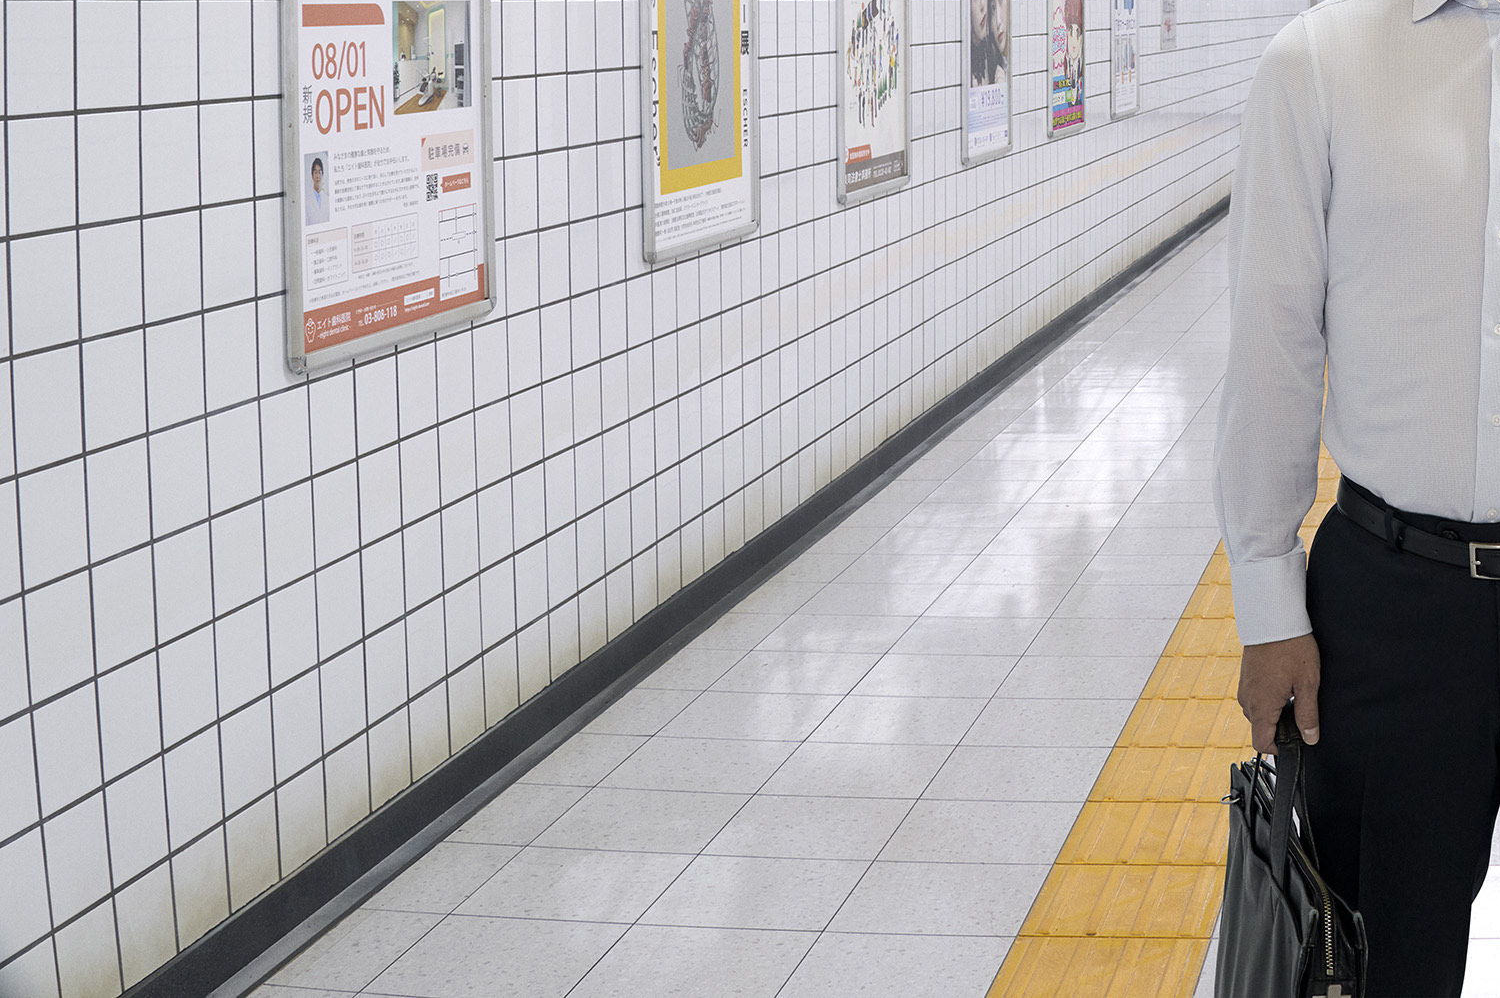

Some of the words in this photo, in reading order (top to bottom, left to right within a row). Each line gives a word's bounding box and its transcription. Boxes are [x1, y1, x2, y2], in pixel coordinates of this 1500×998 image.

[312, 40, 366, 81] 08/01
[303, 85, 313, 124] 新規
[315, 85, 385, 135] OPEN
[428, 143, 460, 160] 駐車場完備
[317, 312, 351, 330] エイト歯科医院
[364, 305, 398, 325] 03-808-118
